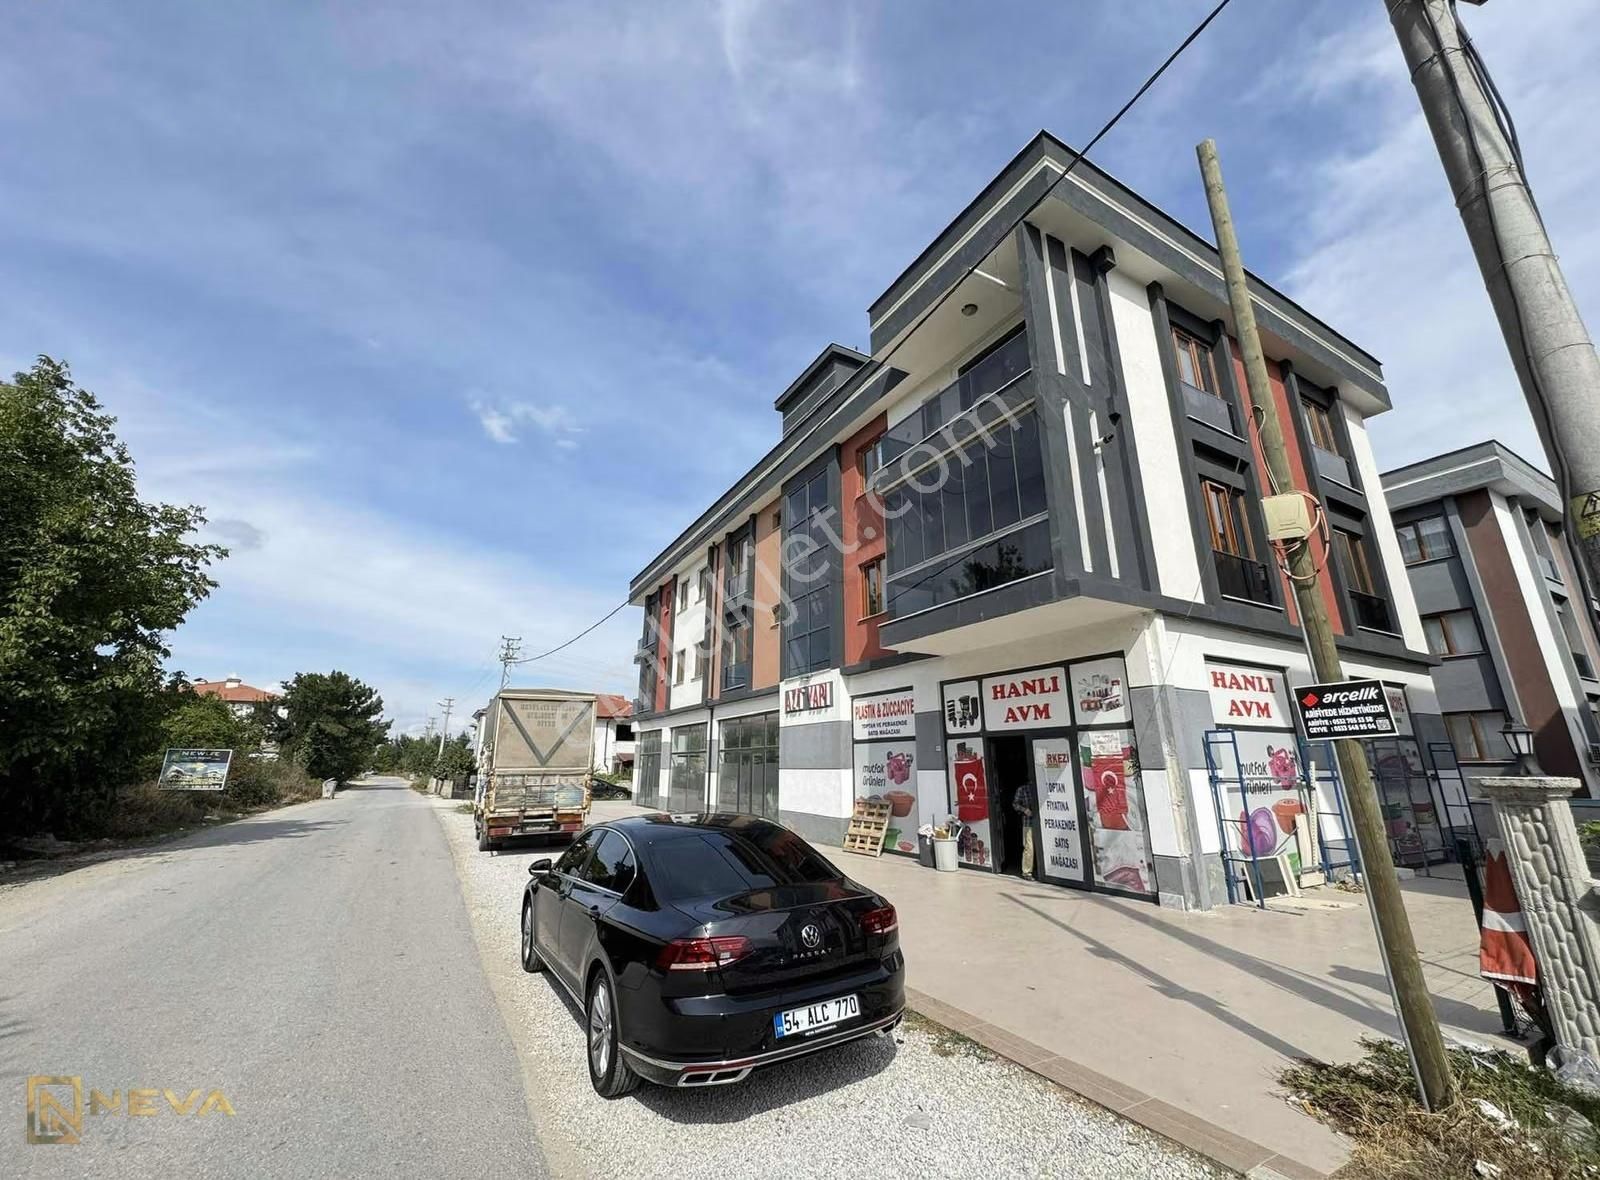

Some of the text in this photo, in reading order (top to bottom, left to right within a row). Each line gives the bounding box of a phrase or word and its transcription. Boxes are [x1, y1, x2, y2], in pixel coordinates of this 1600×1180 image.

[991, 676, 1060, 700] HANLI
[1210, 671, 1276, 694] HANLI
[1004, 703, 1052, 723] AVM
[1228, 699, 1272, 718] AVM
[1046, 753, 1069, 764] RKEZİ
[1246, 780, 1272, 795] rünleri
[1044, 818, 1077, 831] PERAKENDE
[792, 947, 832, 960] PASSAT
[784, 1011, 800, 1032] 54
[808, 1003, 830, 1027] ALC
[835, 996, 857, 1018] 770
